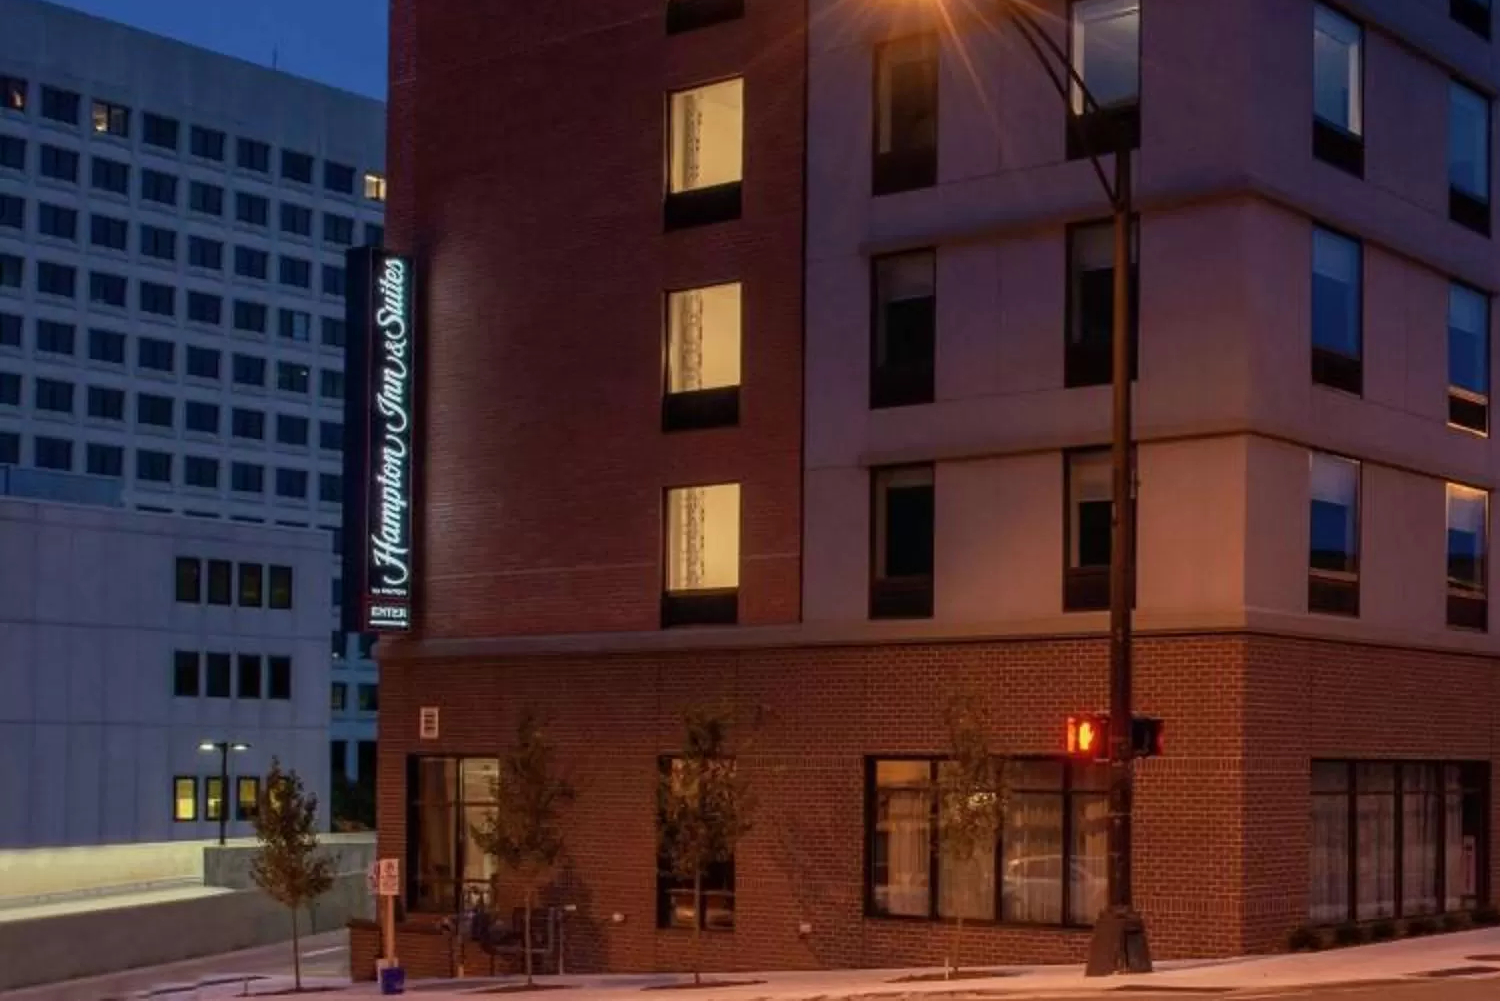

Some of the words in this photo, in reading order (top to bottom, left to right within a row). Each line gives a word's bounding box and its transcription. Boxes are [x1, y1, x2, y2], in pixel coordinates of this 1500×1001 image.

[376, 258, 406, 340] Suites
[384, 338, 408, 358] &
[376, 355, 408, 433] Inn
[371, 434, 409, 585] Hampton
[371, 606, 407, 618] ENTER
